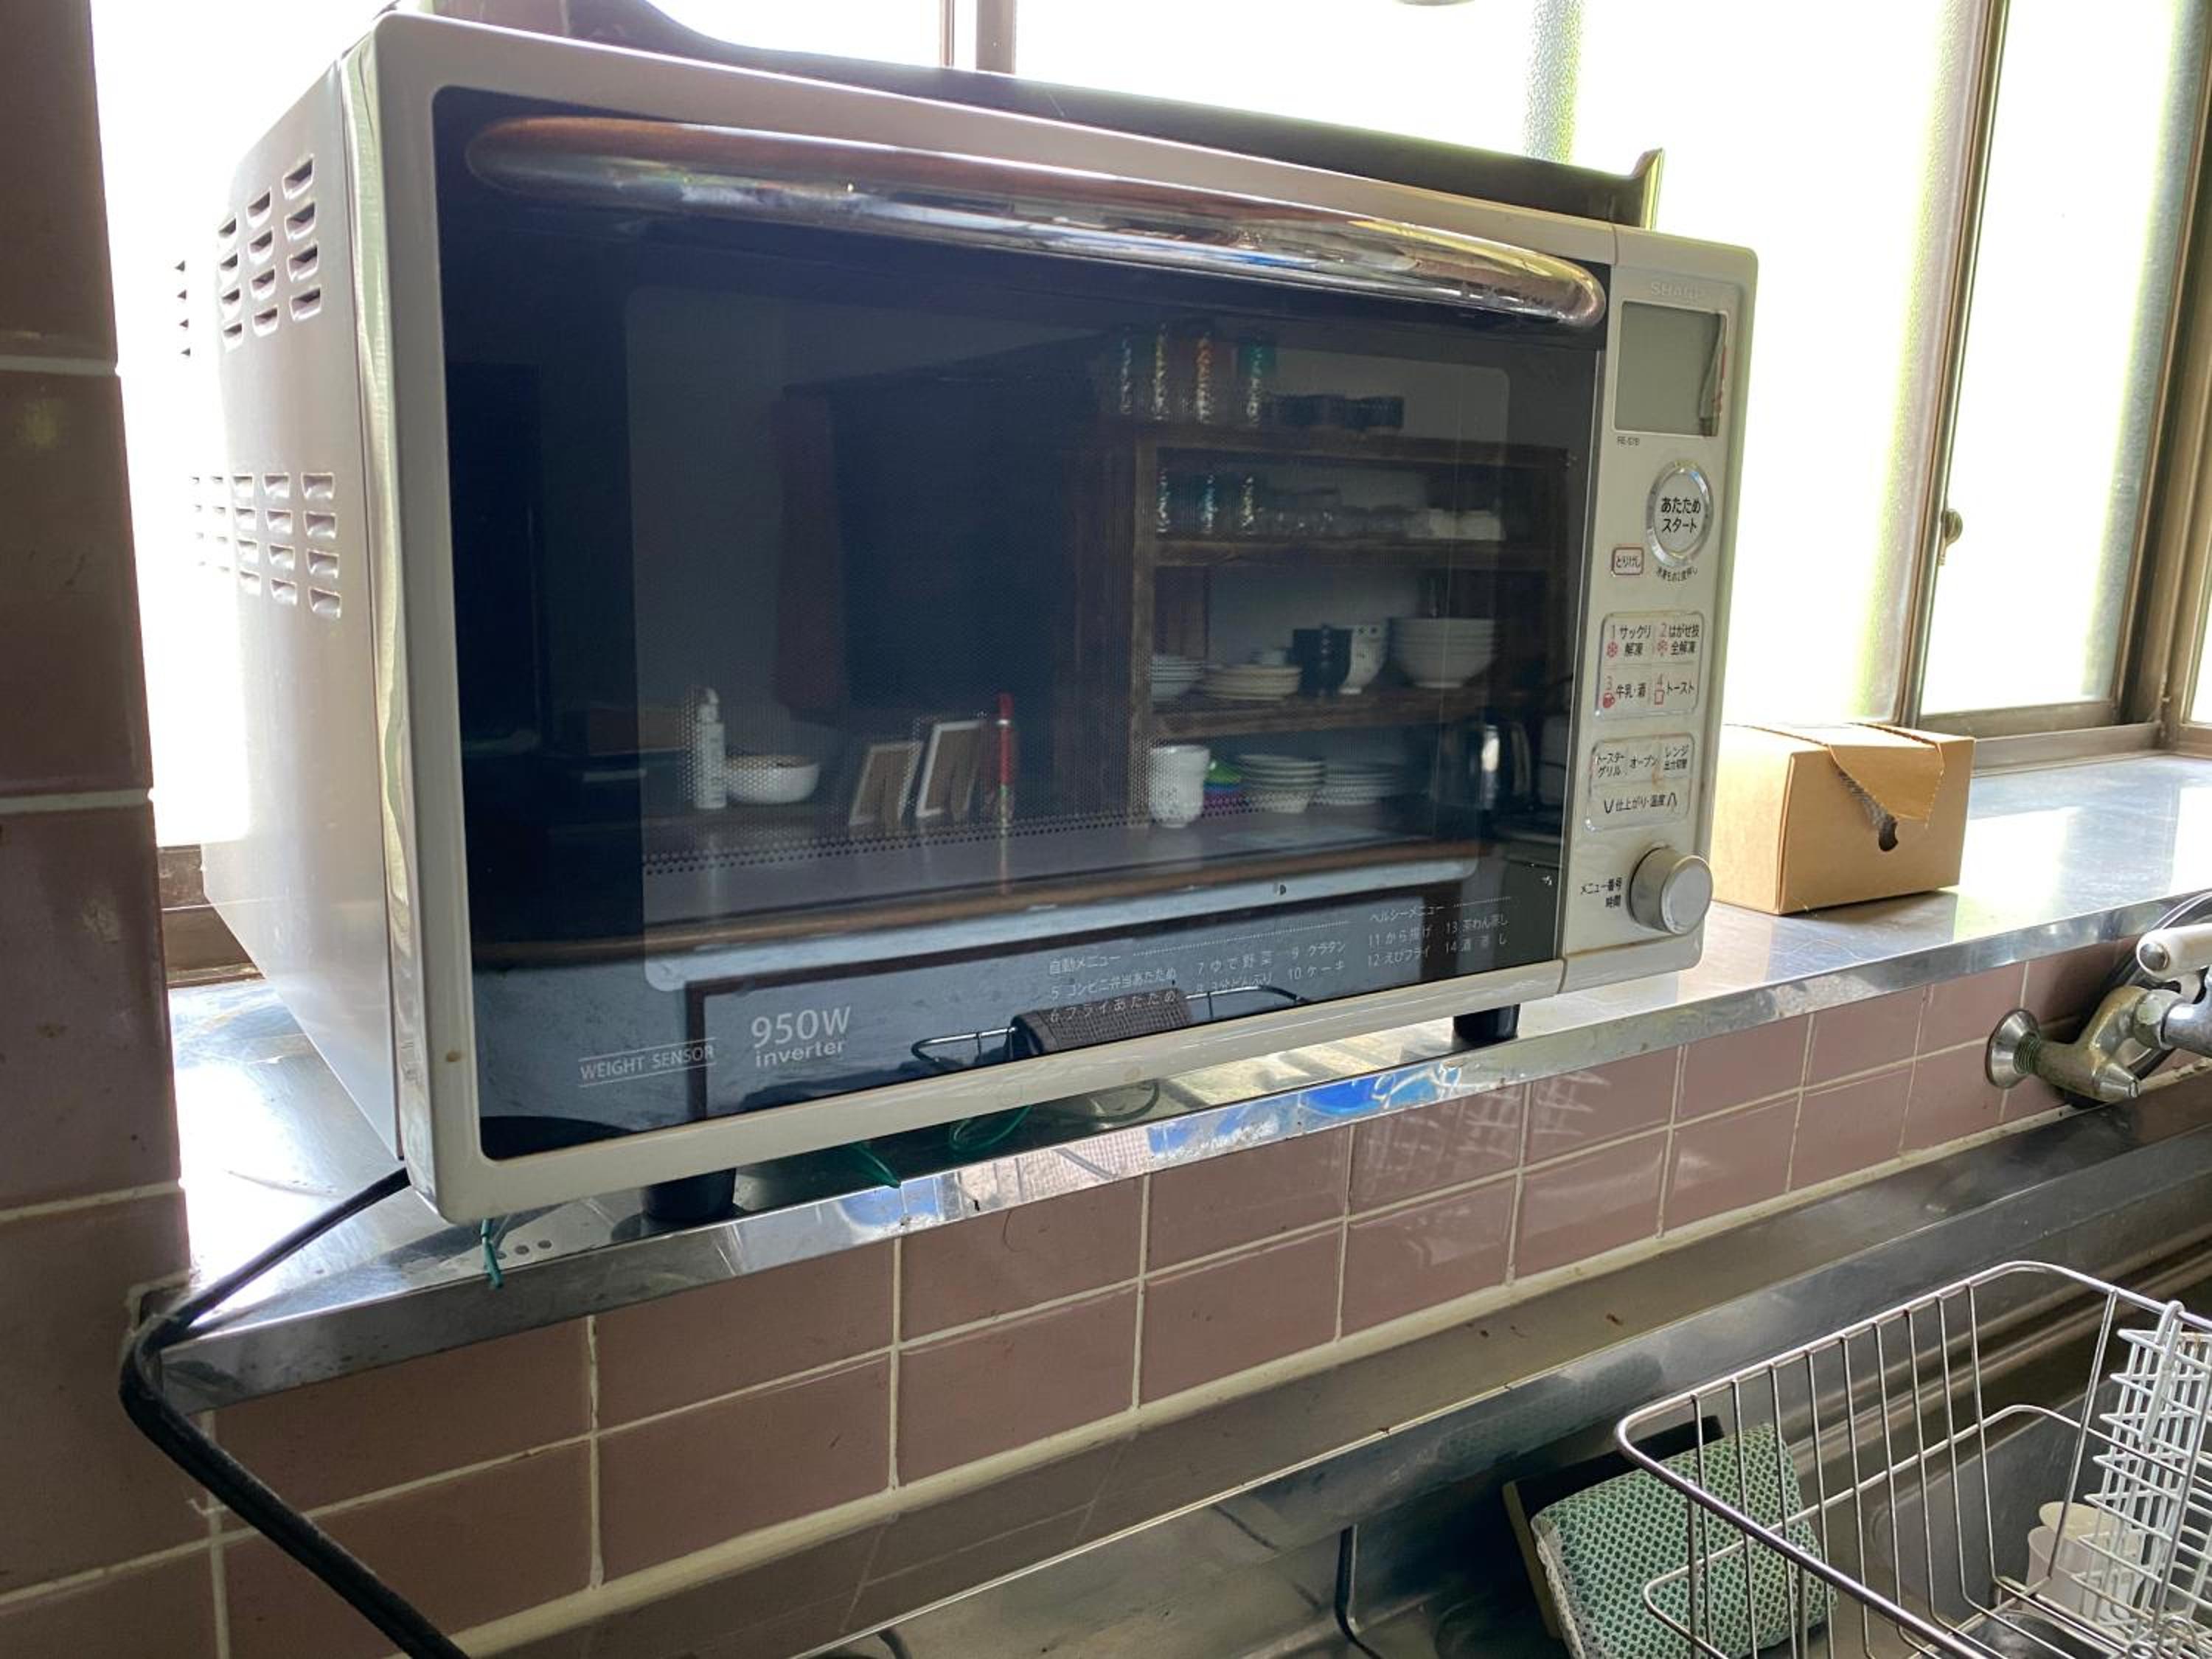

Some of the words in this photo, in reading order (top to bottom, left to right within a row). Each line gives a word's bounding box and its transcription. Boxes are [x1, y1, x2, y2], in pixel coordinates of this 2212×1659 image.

[1660, 497, 1701, 514] あたため
[1661, 518, 1697, 533] スタート
[1615, 556, 1641, 568] とりけし
[1620, 625, 1651, 640] サックリ
[1666, 680, 1694, 695] トースト
[1369, 905, 1445, 922] ヘルシーメニュー
[1445, 921, 1458, 934] 13
[1368, 933, 1380, 948] 11
[1445, 940, 1458, 954] 14
[1309, 942, 1345, 958] グラタン
[1049, 955, 1121, 975] 自動メニュー
[1368, 953, 1380, 967] 12
[1289, 966, 1301, 980] 10
[1307, 961, 1345, 978] ケーキ
[1051, 985, 1060, 1000] 5
[1067, 967, 1177, 996] コンビニ弁当あたため
[1050, 1008, 1060, 1023] 6
[751, 1005, 851, 1048] 950W
[756, 1040, 847, 1068] inverter
[580, 1059, 644, 1081] WEIGHT
[652, 1044, 715, 1068] SENSOR
